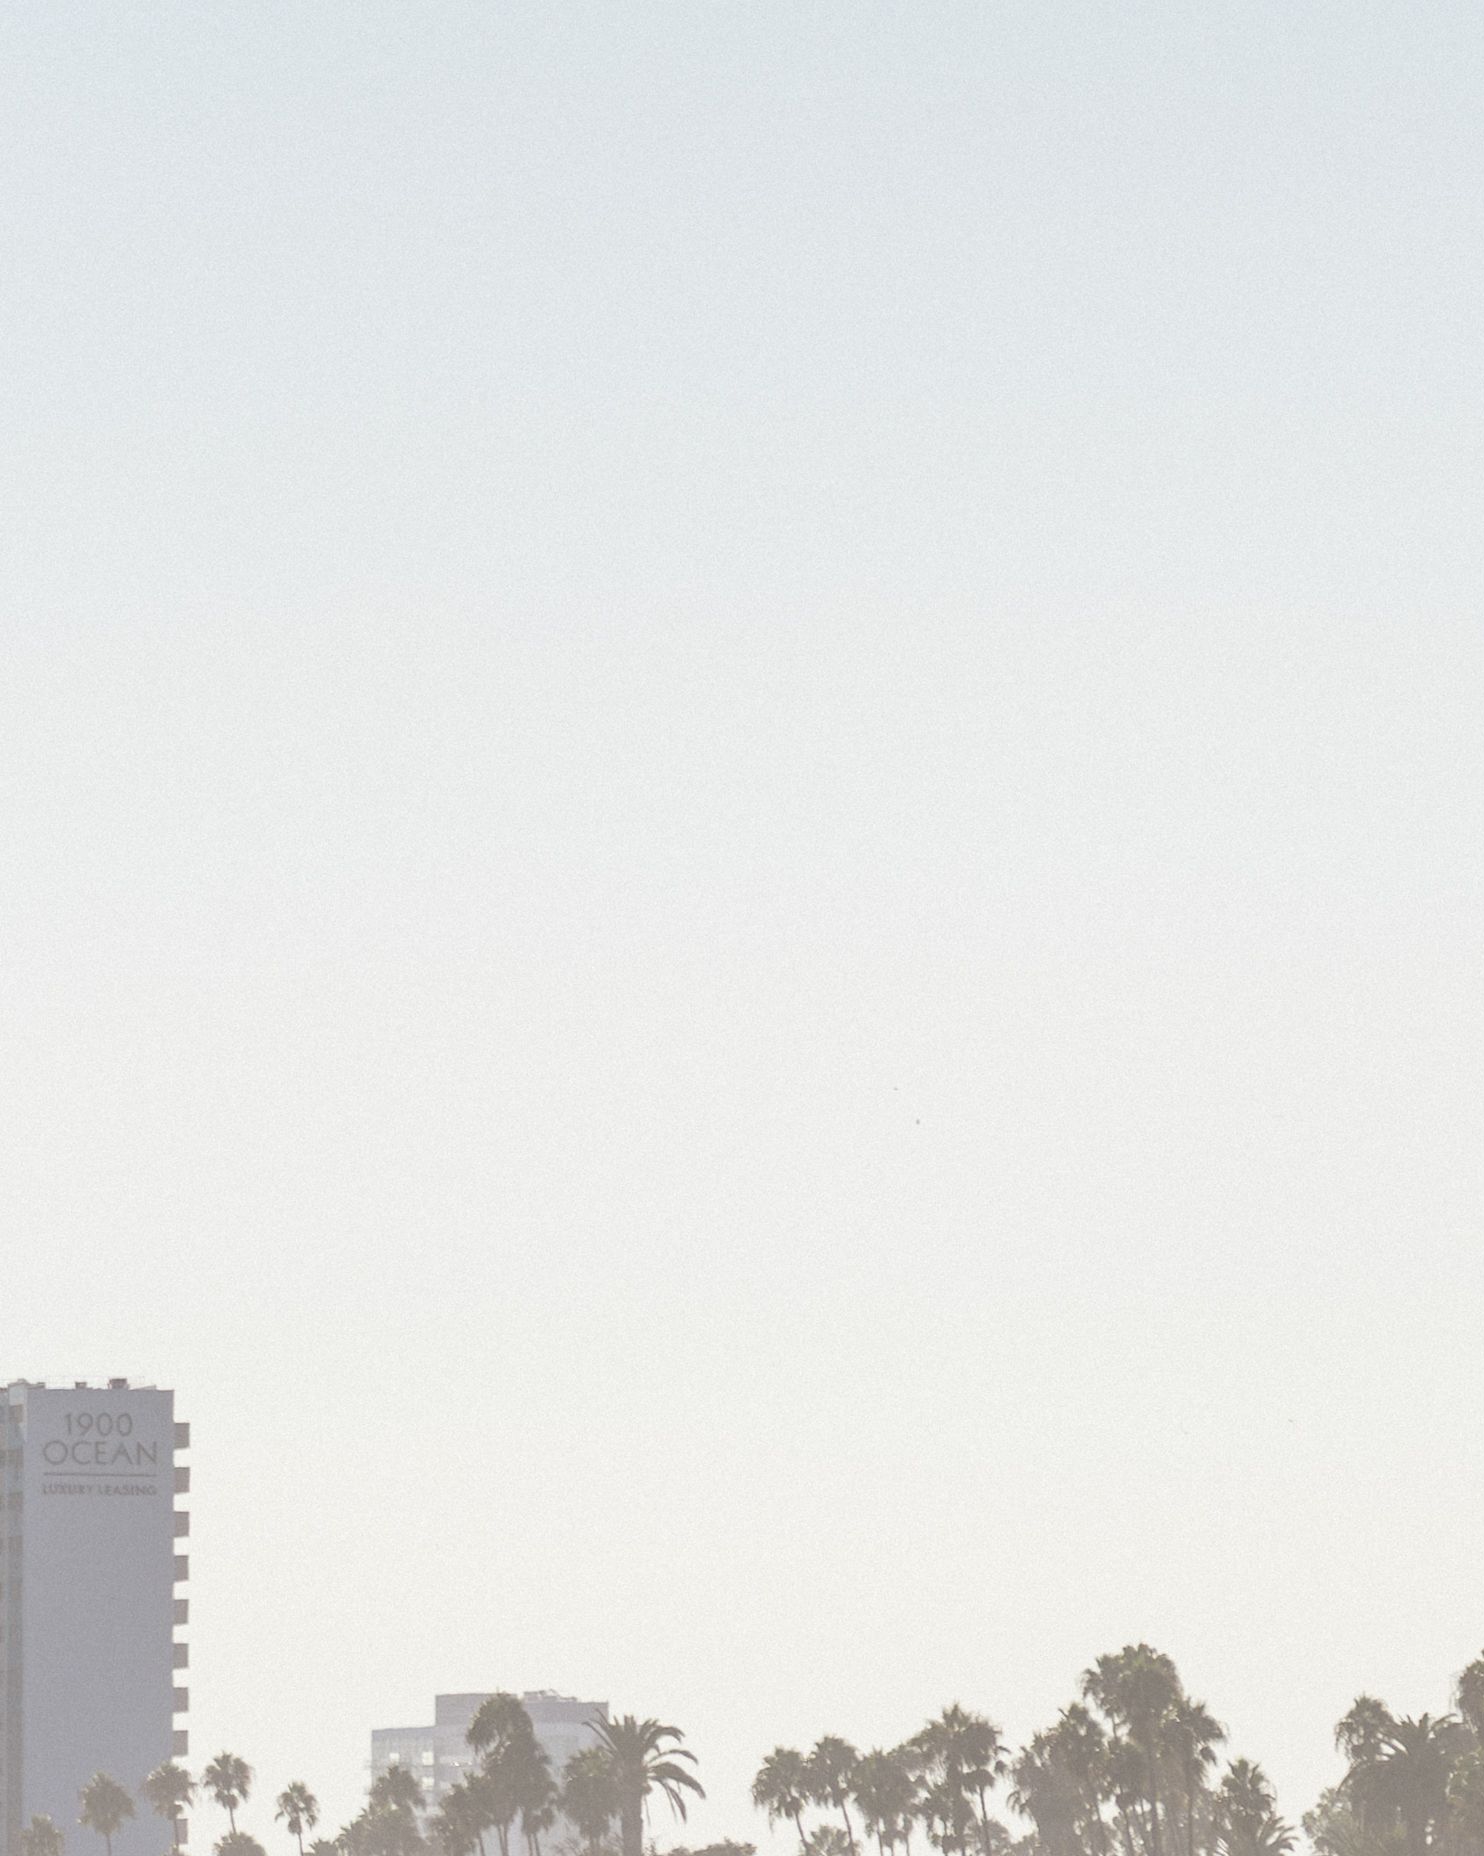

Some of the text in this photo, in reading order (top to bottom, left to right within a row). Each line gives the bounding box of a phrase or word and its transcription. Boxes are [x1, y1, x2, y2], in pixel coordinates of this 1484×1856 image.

[65, 1412, 133, 1437] 1900
[43, 1440, 158, 1465] OCEAN
[42, 1484, 157, 1496] LUXURY LEASING
